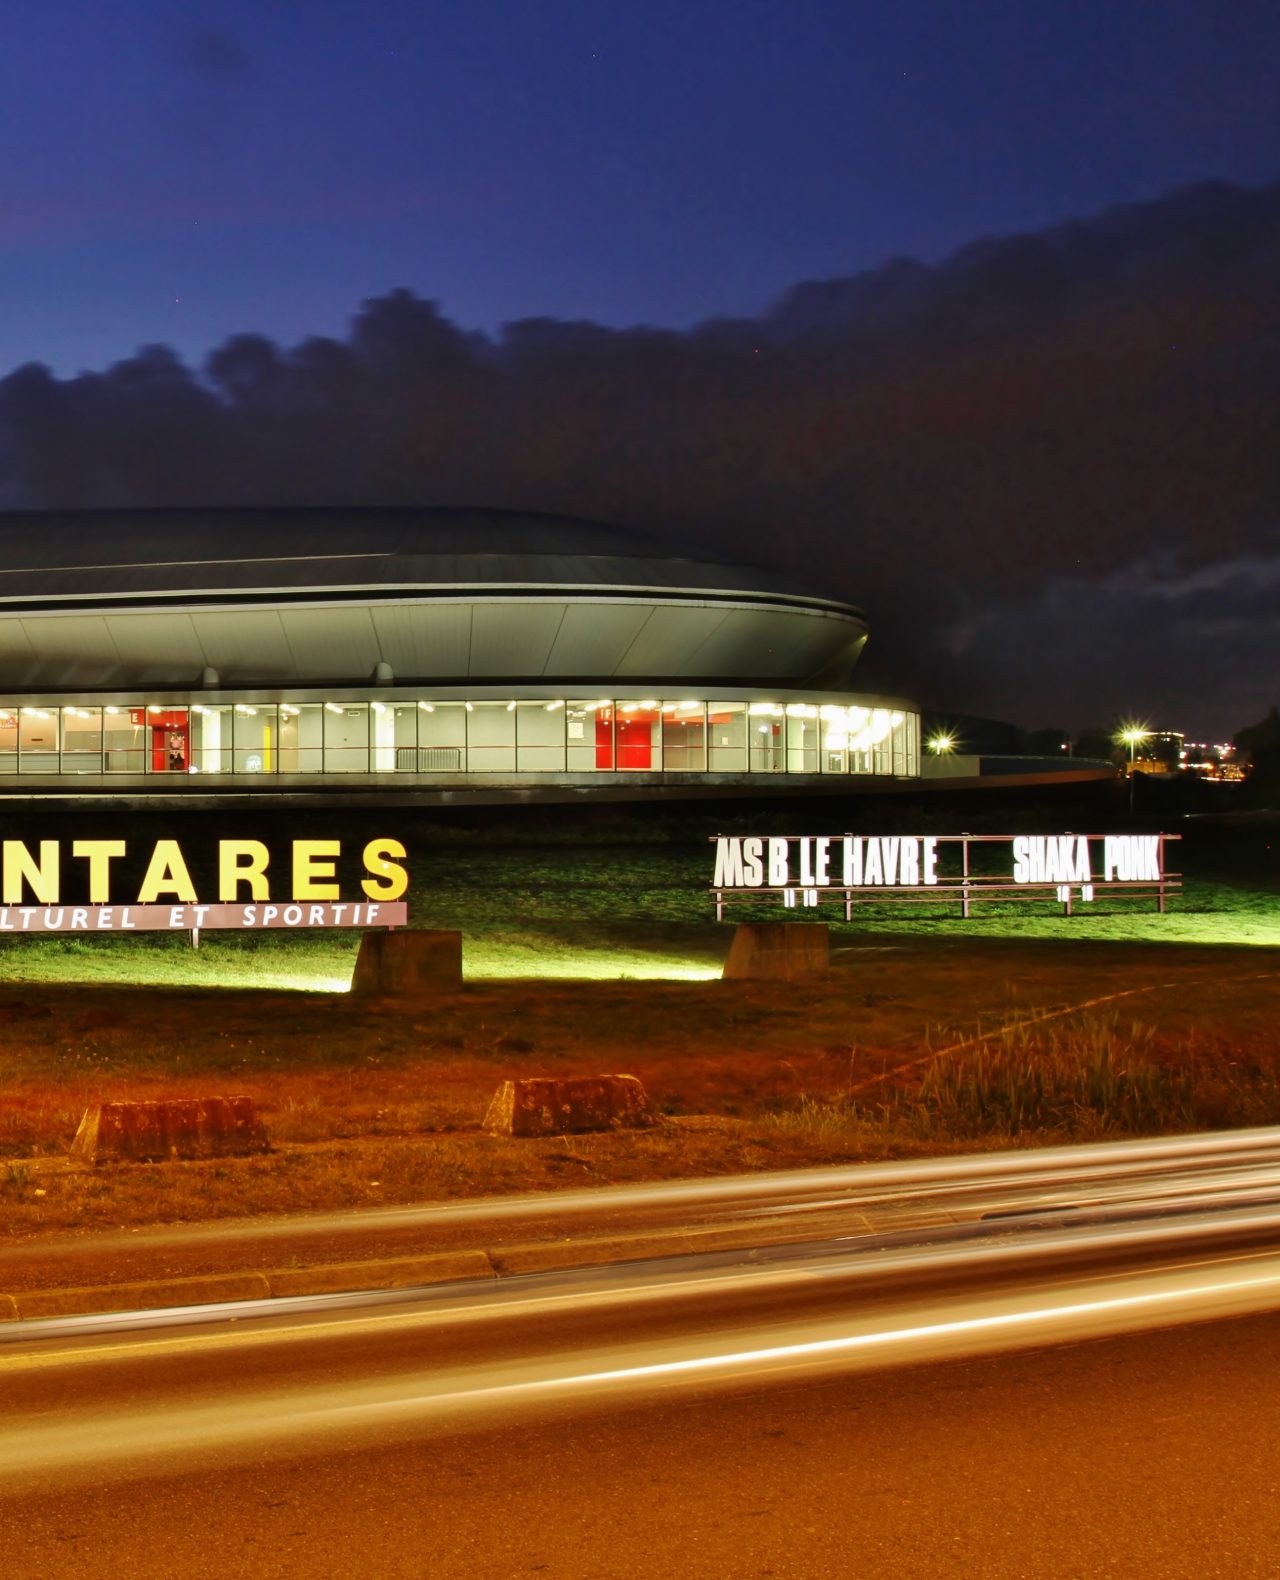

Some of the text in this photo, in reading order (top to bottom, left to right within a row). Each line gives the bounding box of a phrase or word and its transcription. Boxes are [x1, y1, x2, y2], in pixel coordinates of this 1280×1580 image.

[132, 712, 138, 723] E
[800, 836, 830, 886] LE
[842, 836, 938, 886] HAVRE
[1013, 835, 1160, 883] SHAKA PONK
[803, 888, 818, 907] 10
[169, 906, 210, 928] ET
[242, 904, 380, 927] SPORTIF
